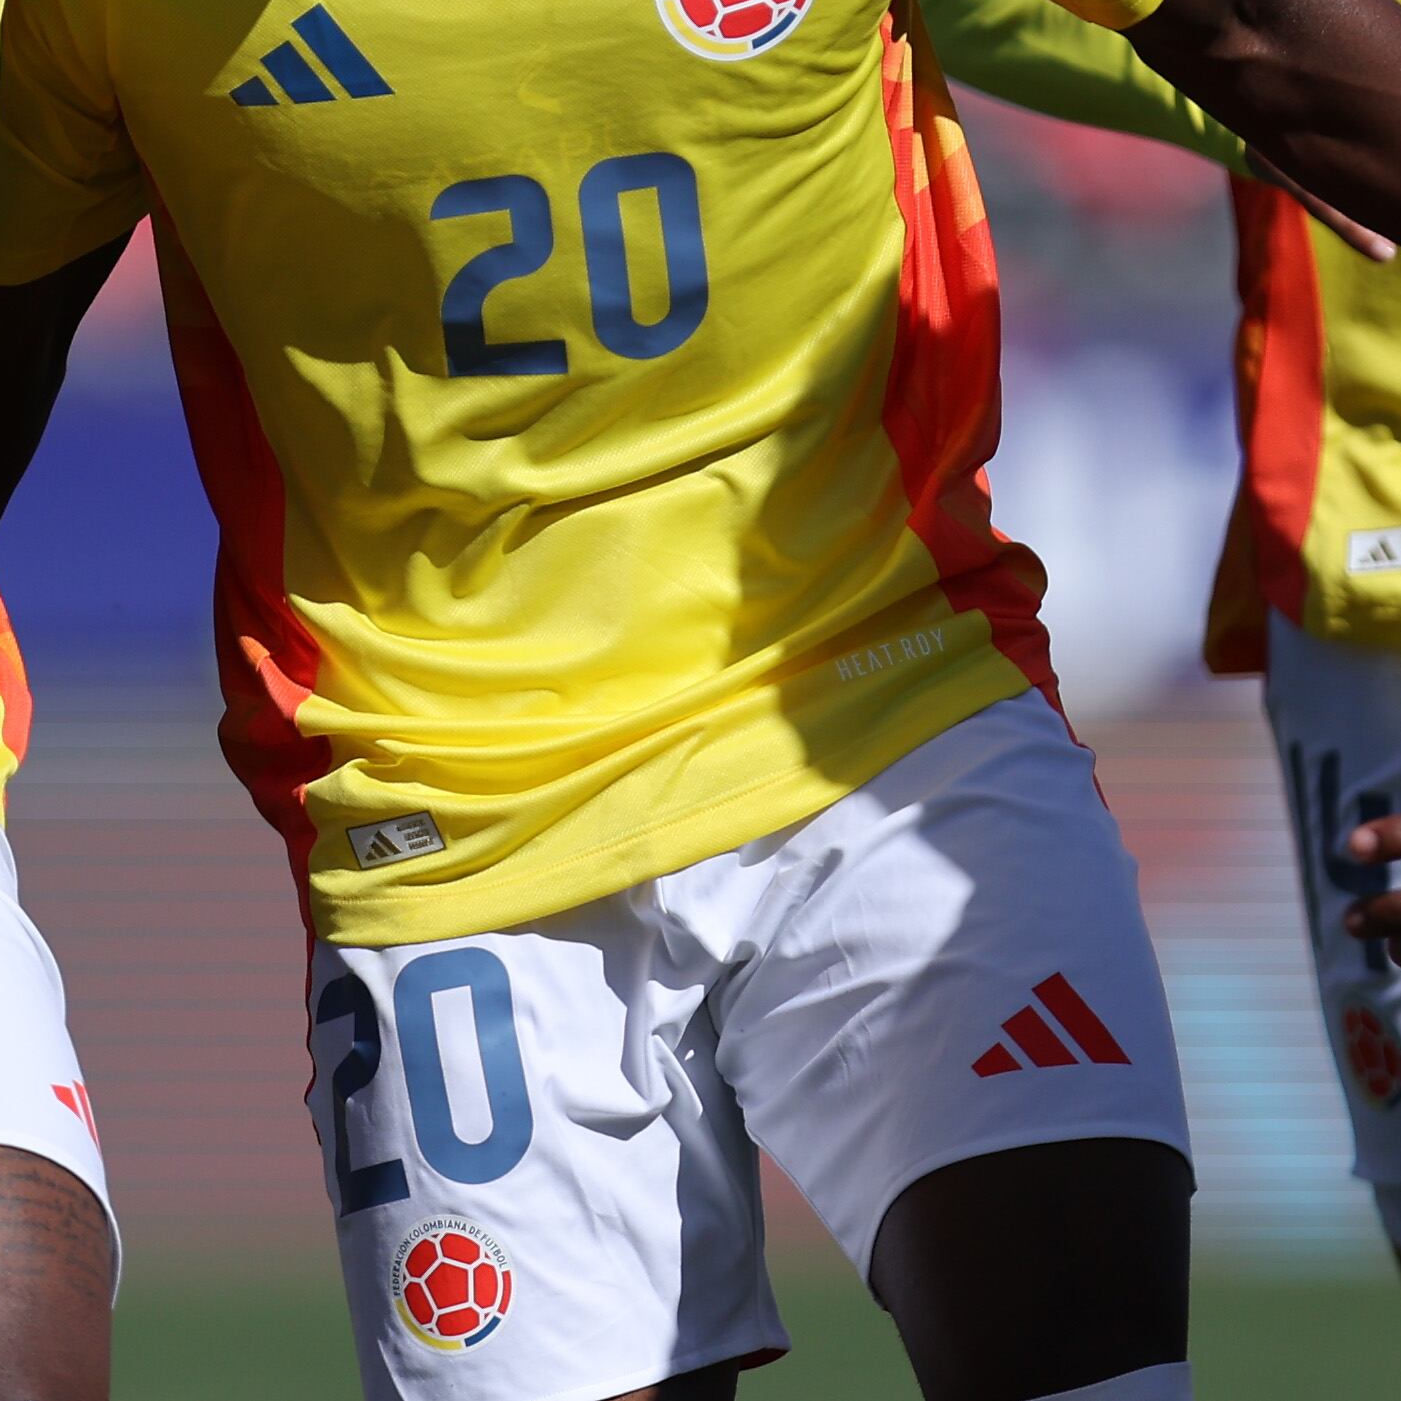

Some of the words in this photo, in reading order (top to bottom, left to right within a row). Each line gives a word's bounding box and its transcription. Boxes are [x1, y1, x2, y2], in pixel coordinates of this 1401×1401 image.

[430, 151, 710, 378] 20
[315, 946, 534, 1217] 20
[409, 1219, 467, 1241] COLOMBIANA
[468, 1225, 482, 1237] DE
